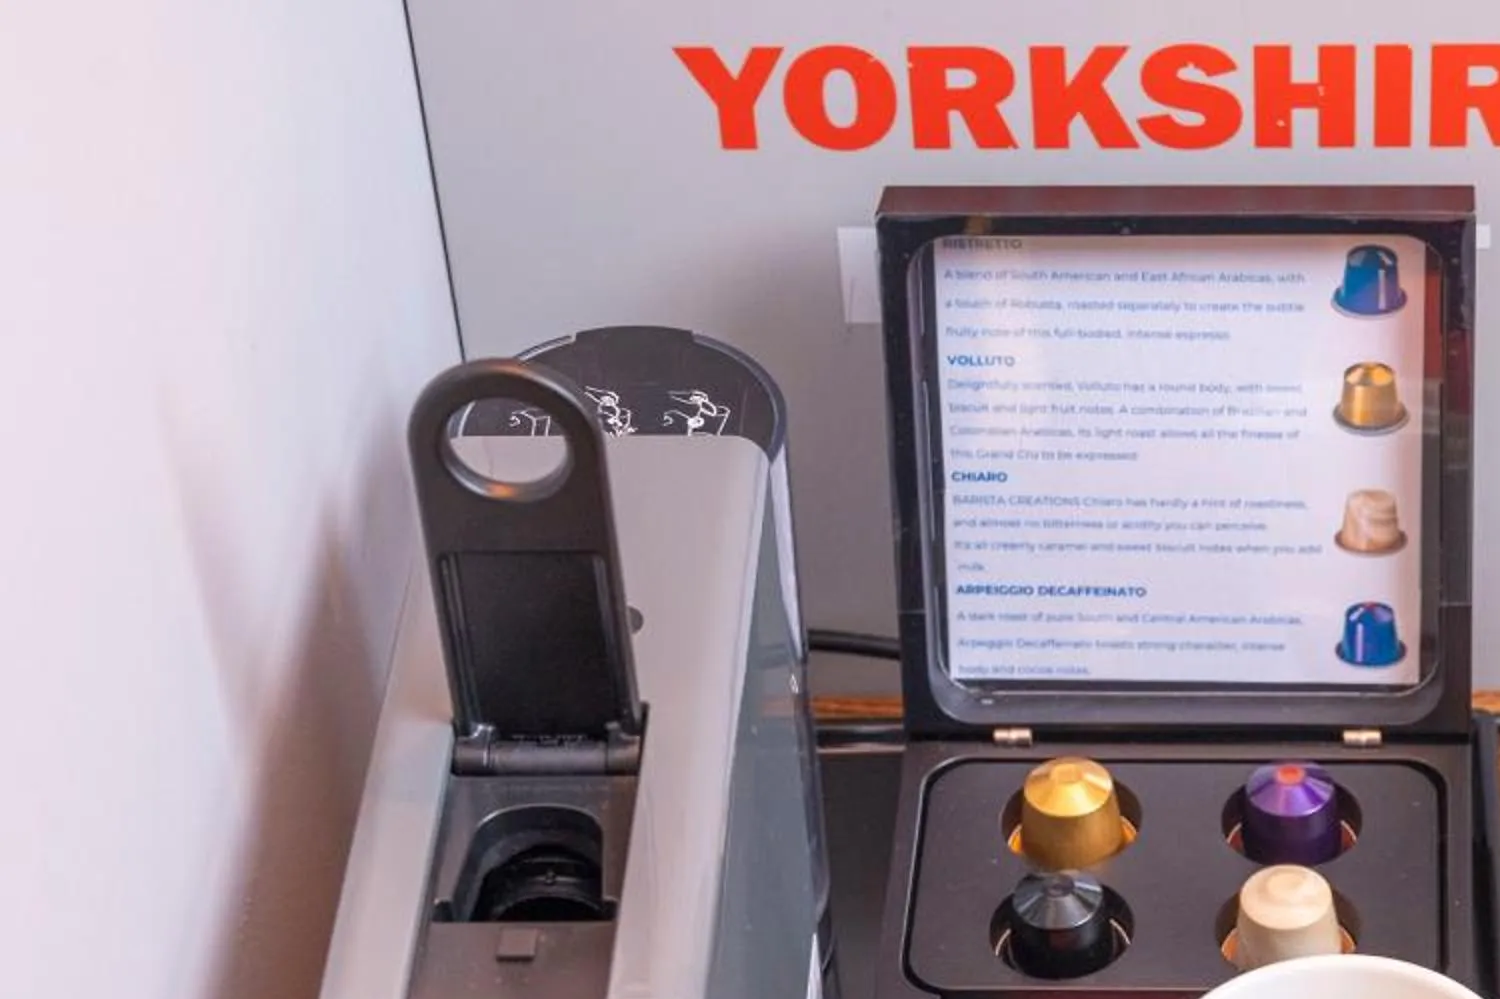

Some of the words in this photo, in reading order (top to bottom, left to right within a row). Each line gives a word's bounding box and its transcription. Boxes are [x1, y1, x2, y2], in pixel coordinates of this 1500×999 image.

[946, 355, 1016, 367] VOLLUTO
[950, 470, 1009, 483] CHIARO
[956, 584, 1034, 596] ARPEGGIO
[1037, 584, 1147, 598] DECAFFEINATO
